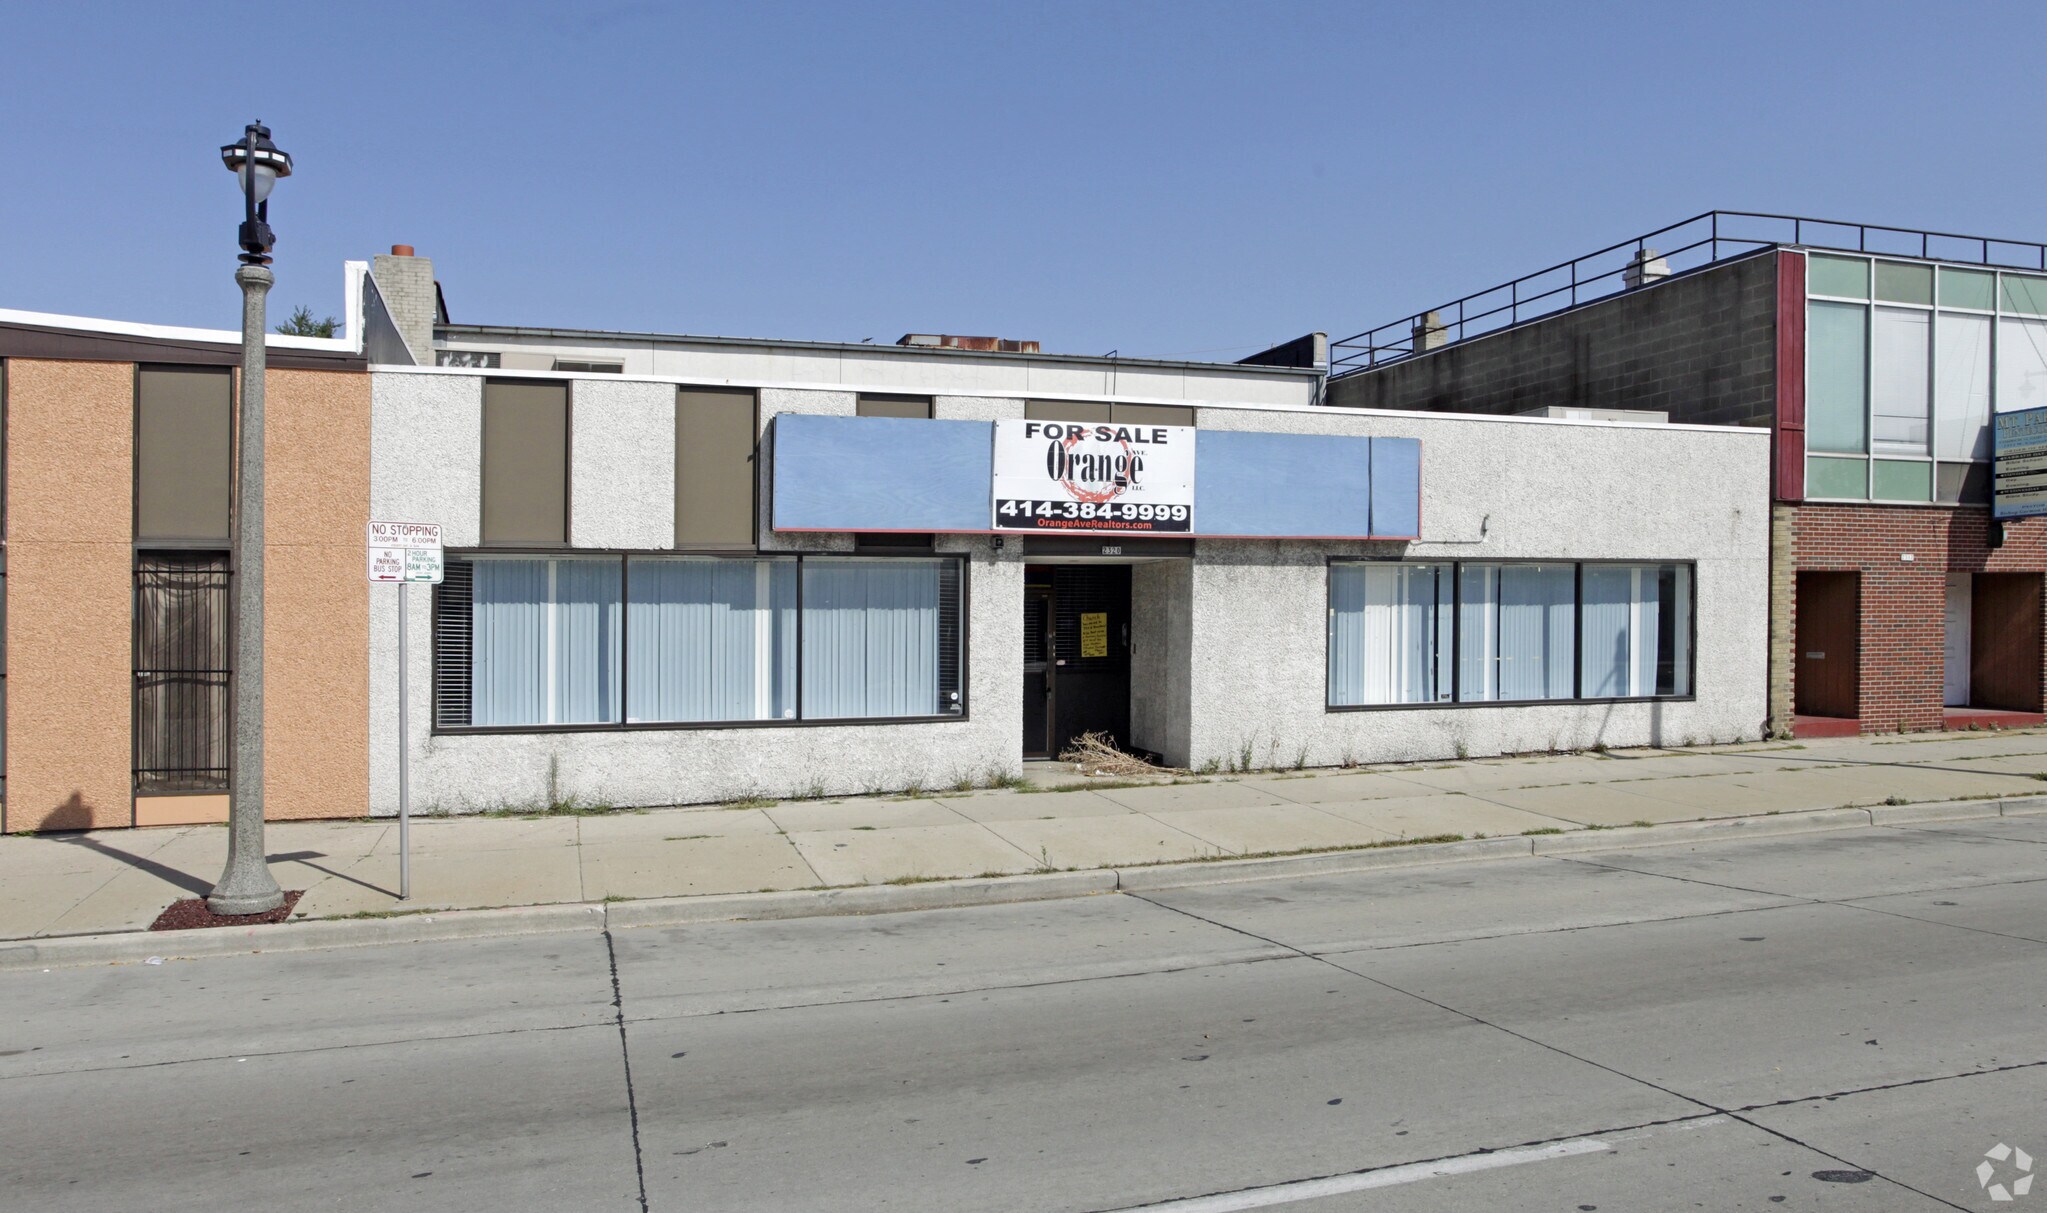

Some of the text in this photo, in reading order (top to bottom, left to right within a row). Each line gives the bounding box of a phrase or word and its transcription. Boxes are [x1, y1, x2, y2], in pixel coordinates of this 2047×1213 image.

[1025, 422, 1168, 445] FOR SALE
[1046, 439, 1144, 495] Orange
[999, 499, 1188, 521] 414-384-9999
[1037, 517, 1153, 530] OrangeAveRealtors.com
[372, 524, 438, 537] NO STOPPING
[376, 558, 400, 566] PARKING
[406, 562, 421, 571] 8AM
[426, 563, 440, 571] 3PM
[373, 565, 402, 573] BUS STOP
